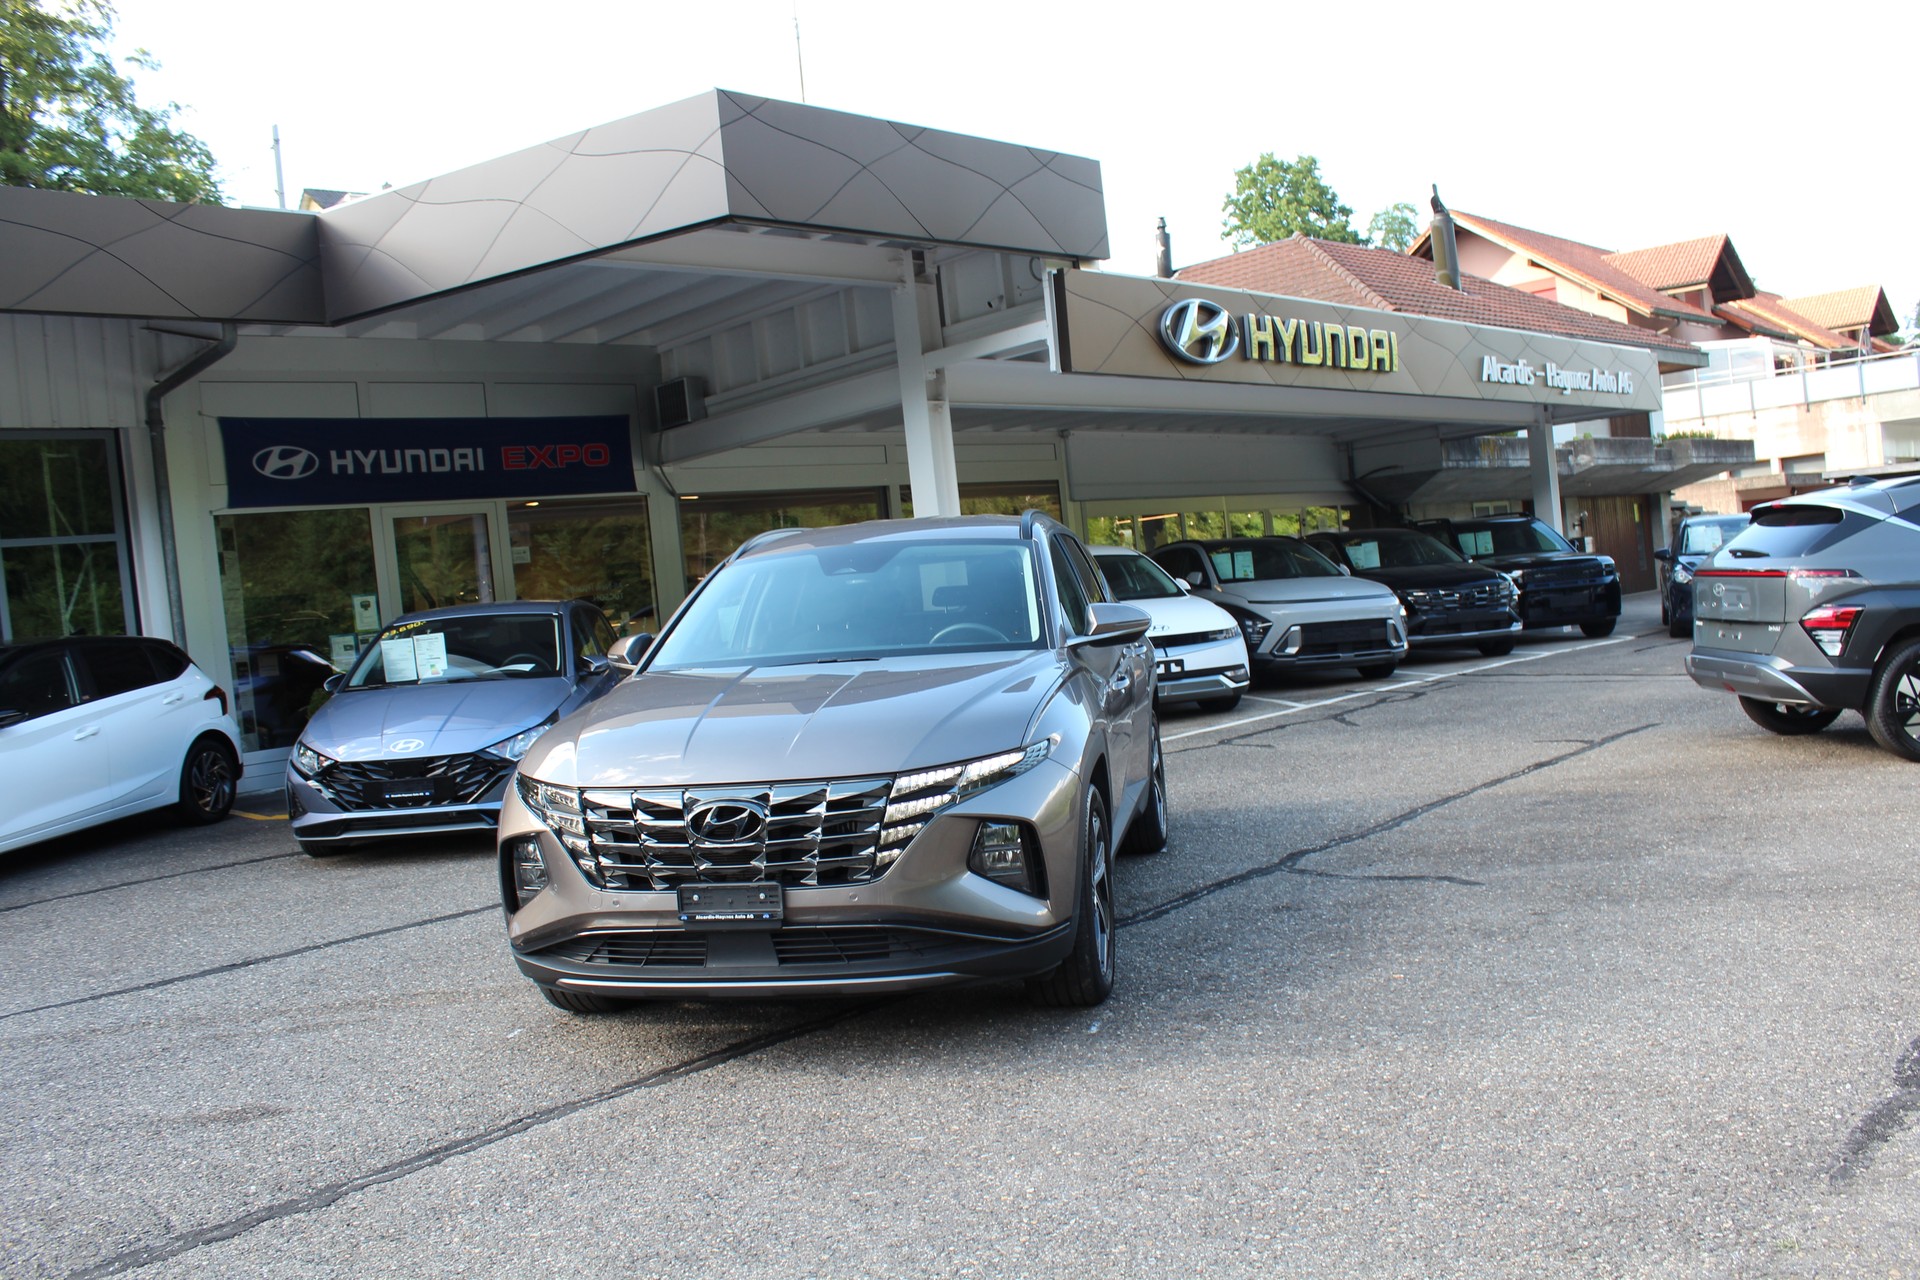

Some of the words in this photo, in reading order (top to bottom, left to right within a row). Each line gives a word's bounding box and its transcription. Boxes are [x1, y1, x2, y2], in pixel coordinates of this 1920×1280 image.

[1244, 313, 1398, 372] HYUNDAI
[1482, 355, 1535, 385] Alcardis
[1545, 362, 1591, 395] Haymoz
[1592, 368, 1617, 393] Auto
[1617, 371, 1633, 394] AG
[330, 448, 484, 474] HYUNDAI
[501, 443, 610, 470] EXPO
